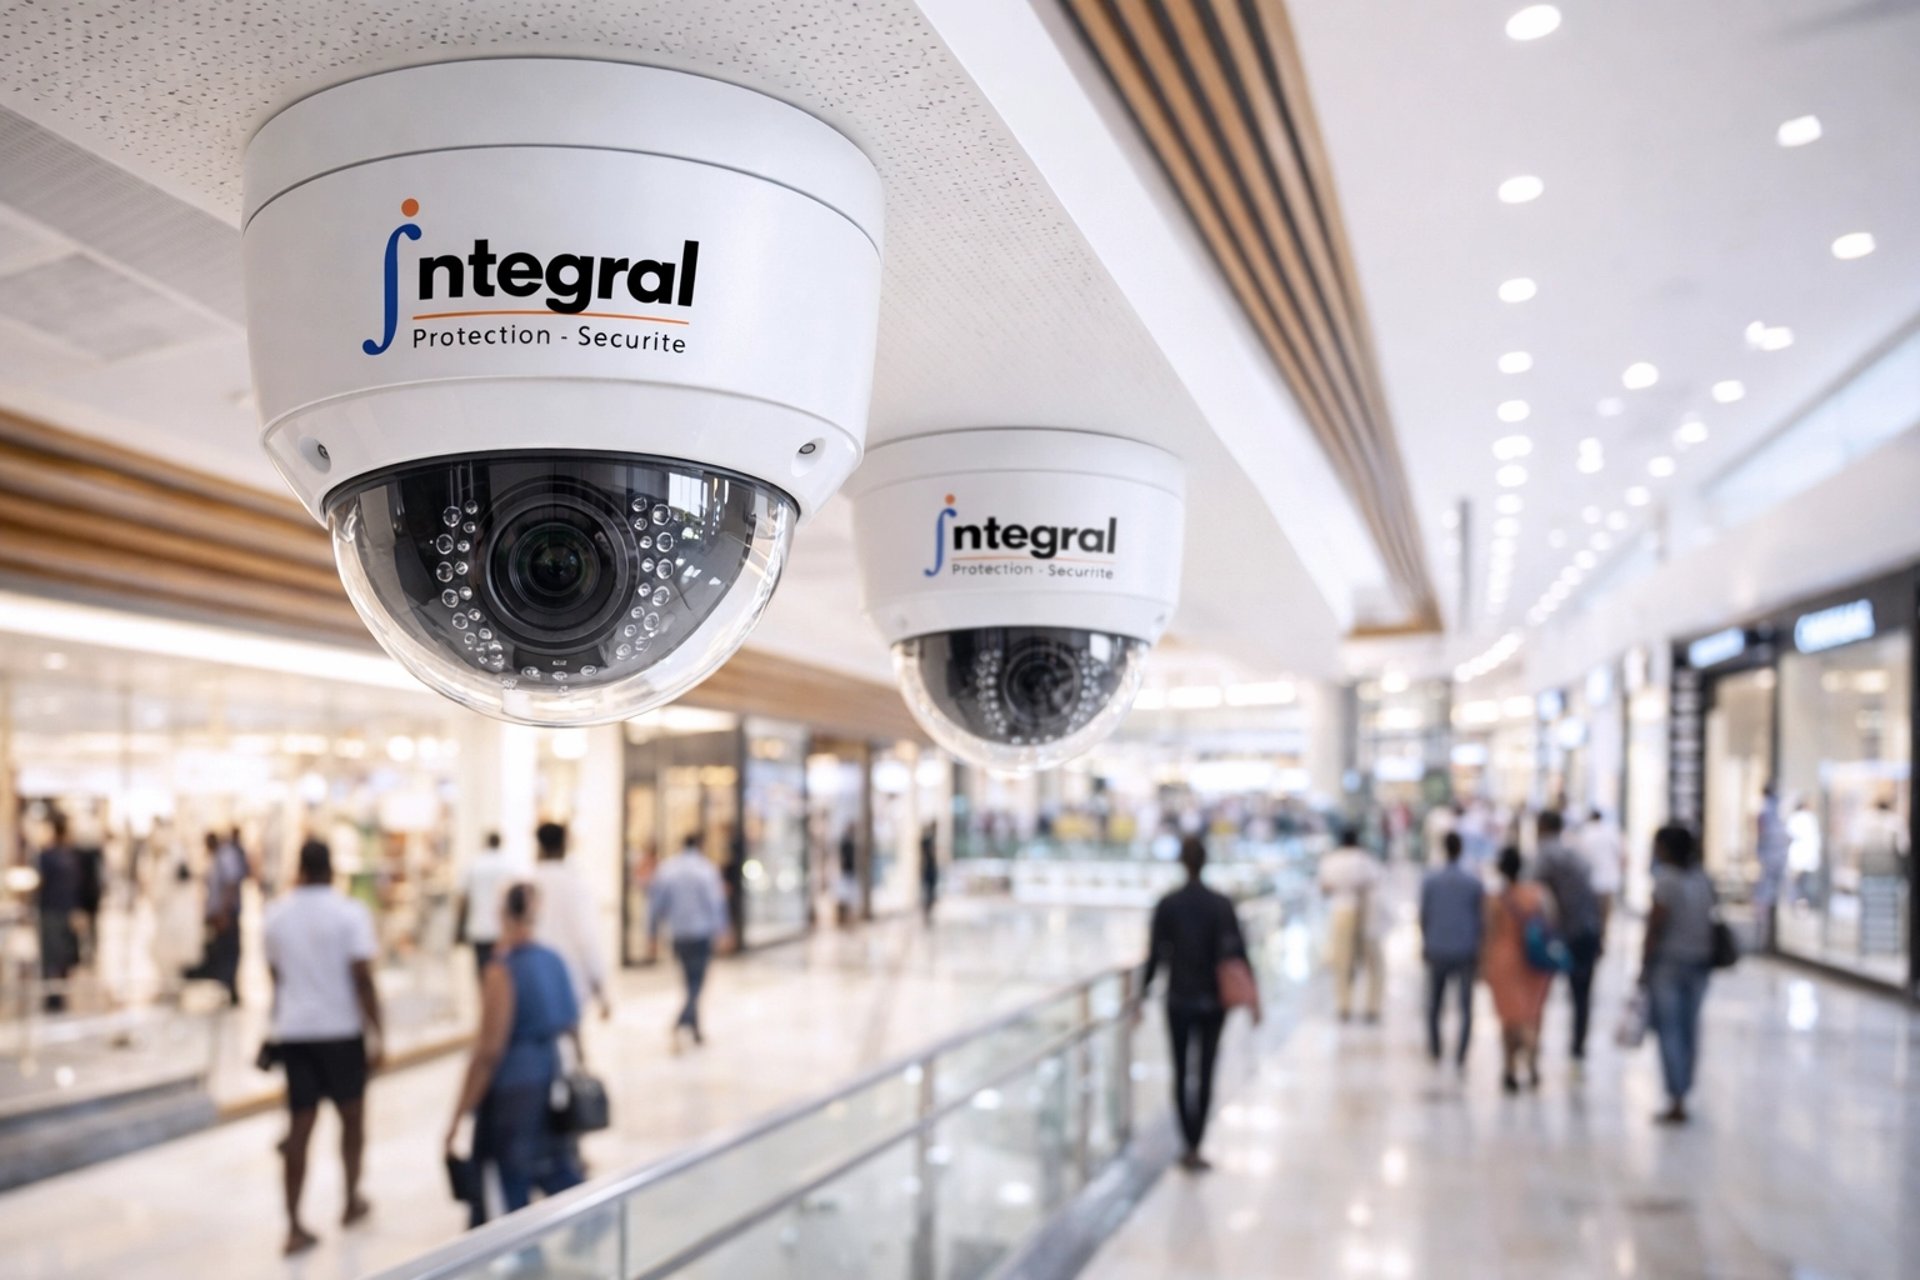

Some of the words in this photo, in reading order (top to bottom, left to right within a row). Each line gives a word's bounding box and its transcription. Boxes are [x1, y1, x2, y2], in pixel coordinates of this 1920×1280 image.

[413, 324, 551, 348] Protection
[578, 326, 686, 353] Securite
[952, 562, 1033, 576] Protection
